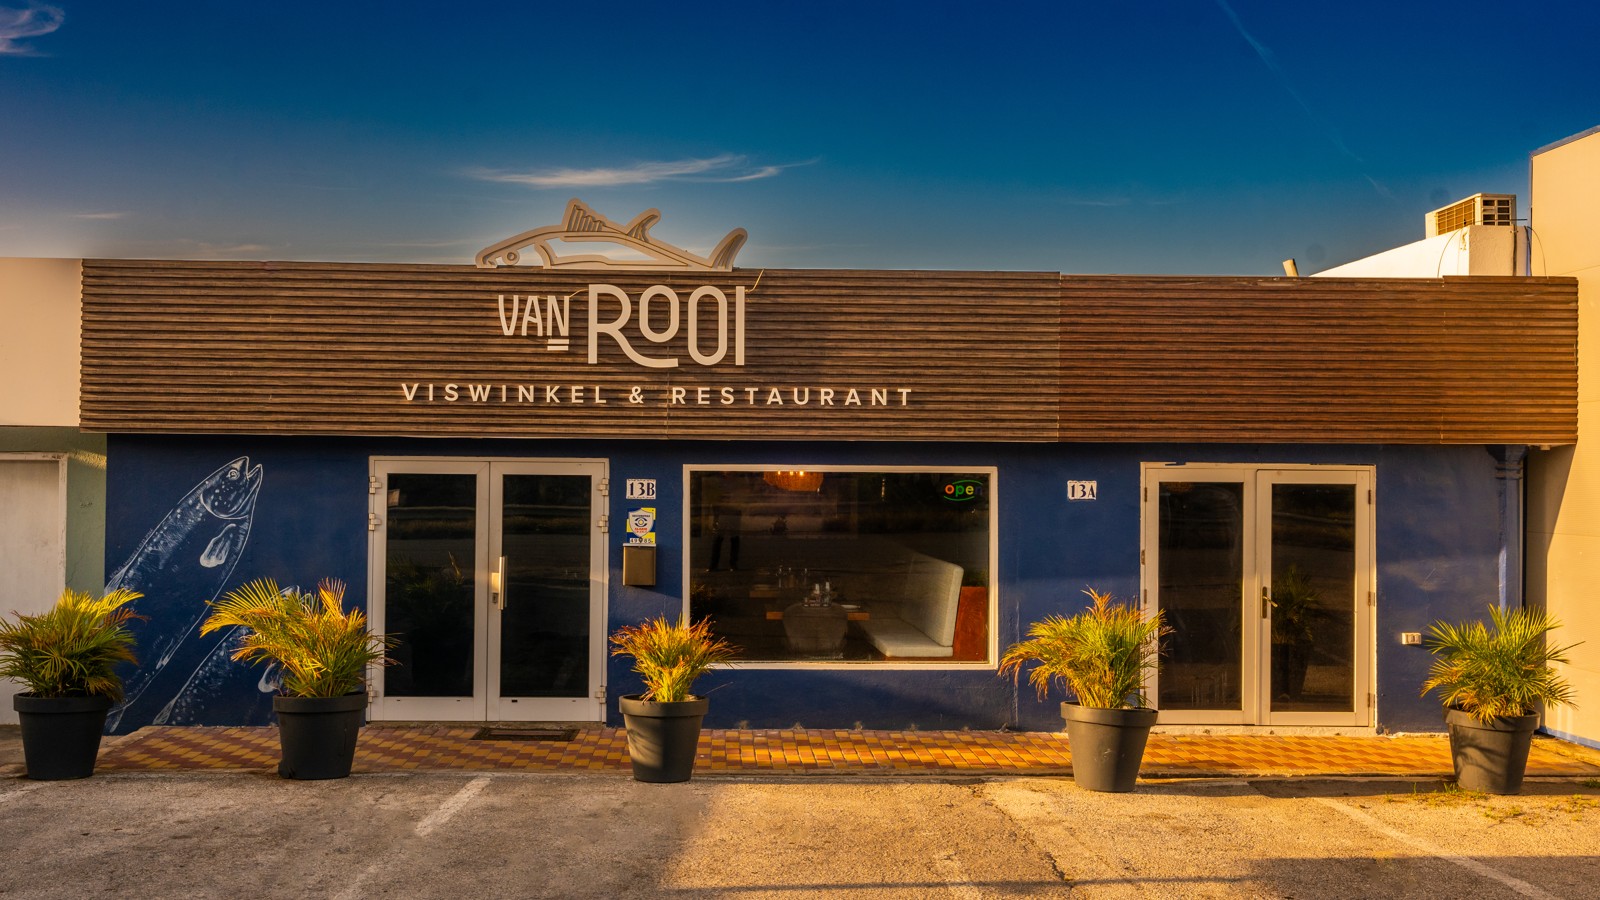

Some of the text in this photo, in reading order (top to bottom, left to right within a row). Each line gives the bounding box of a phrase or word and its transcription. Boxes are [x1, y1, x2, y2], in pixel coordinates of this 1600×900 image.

[498, 283, 746, 369] VAN ROOI
[401, 383, 912, 406] VISWINKEL & RESTAURANT
[629, 482, 655, 497] 13B
[1071, 484, 1096, 498] 13A
